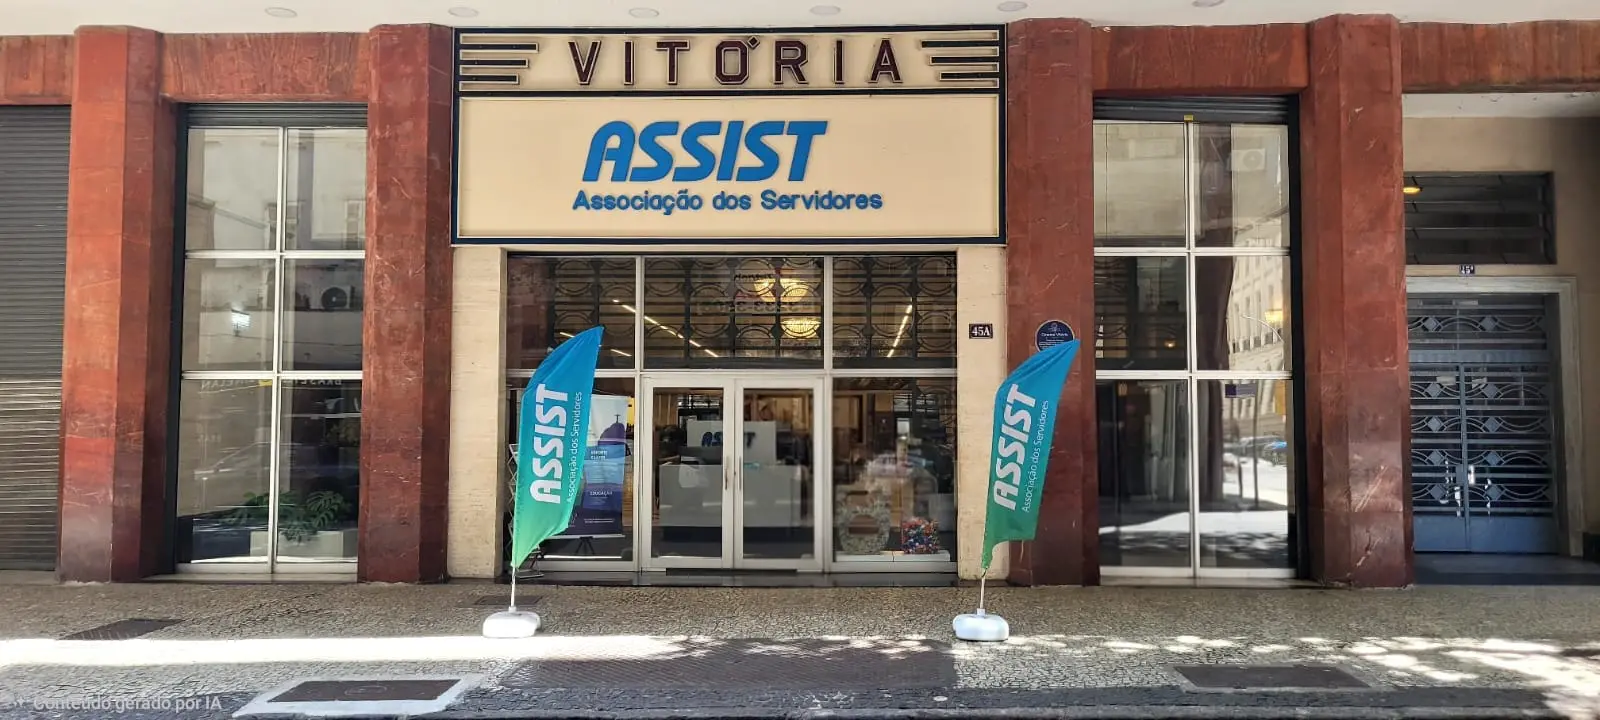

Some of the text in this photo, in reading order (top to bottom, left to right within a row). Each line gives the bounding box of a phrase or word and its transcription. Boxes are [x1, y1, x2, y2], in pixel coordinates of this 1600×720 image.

[568, 36, 903, 86] VITÓRIA
[582, 120, 828, 182] ASSIST
[572, 190, 883, 216] Associação dos Servidores
[971, 326, 991, 336] 45A
[571, 391, 582, 437] Servidores
[530, 384, 568, 504] ASSIST
[570, 439, 579, 455] dos
[993, 384, 1037, 511] ASSIST
[1022, 400, 1049, 513] Associação dos Servidores
